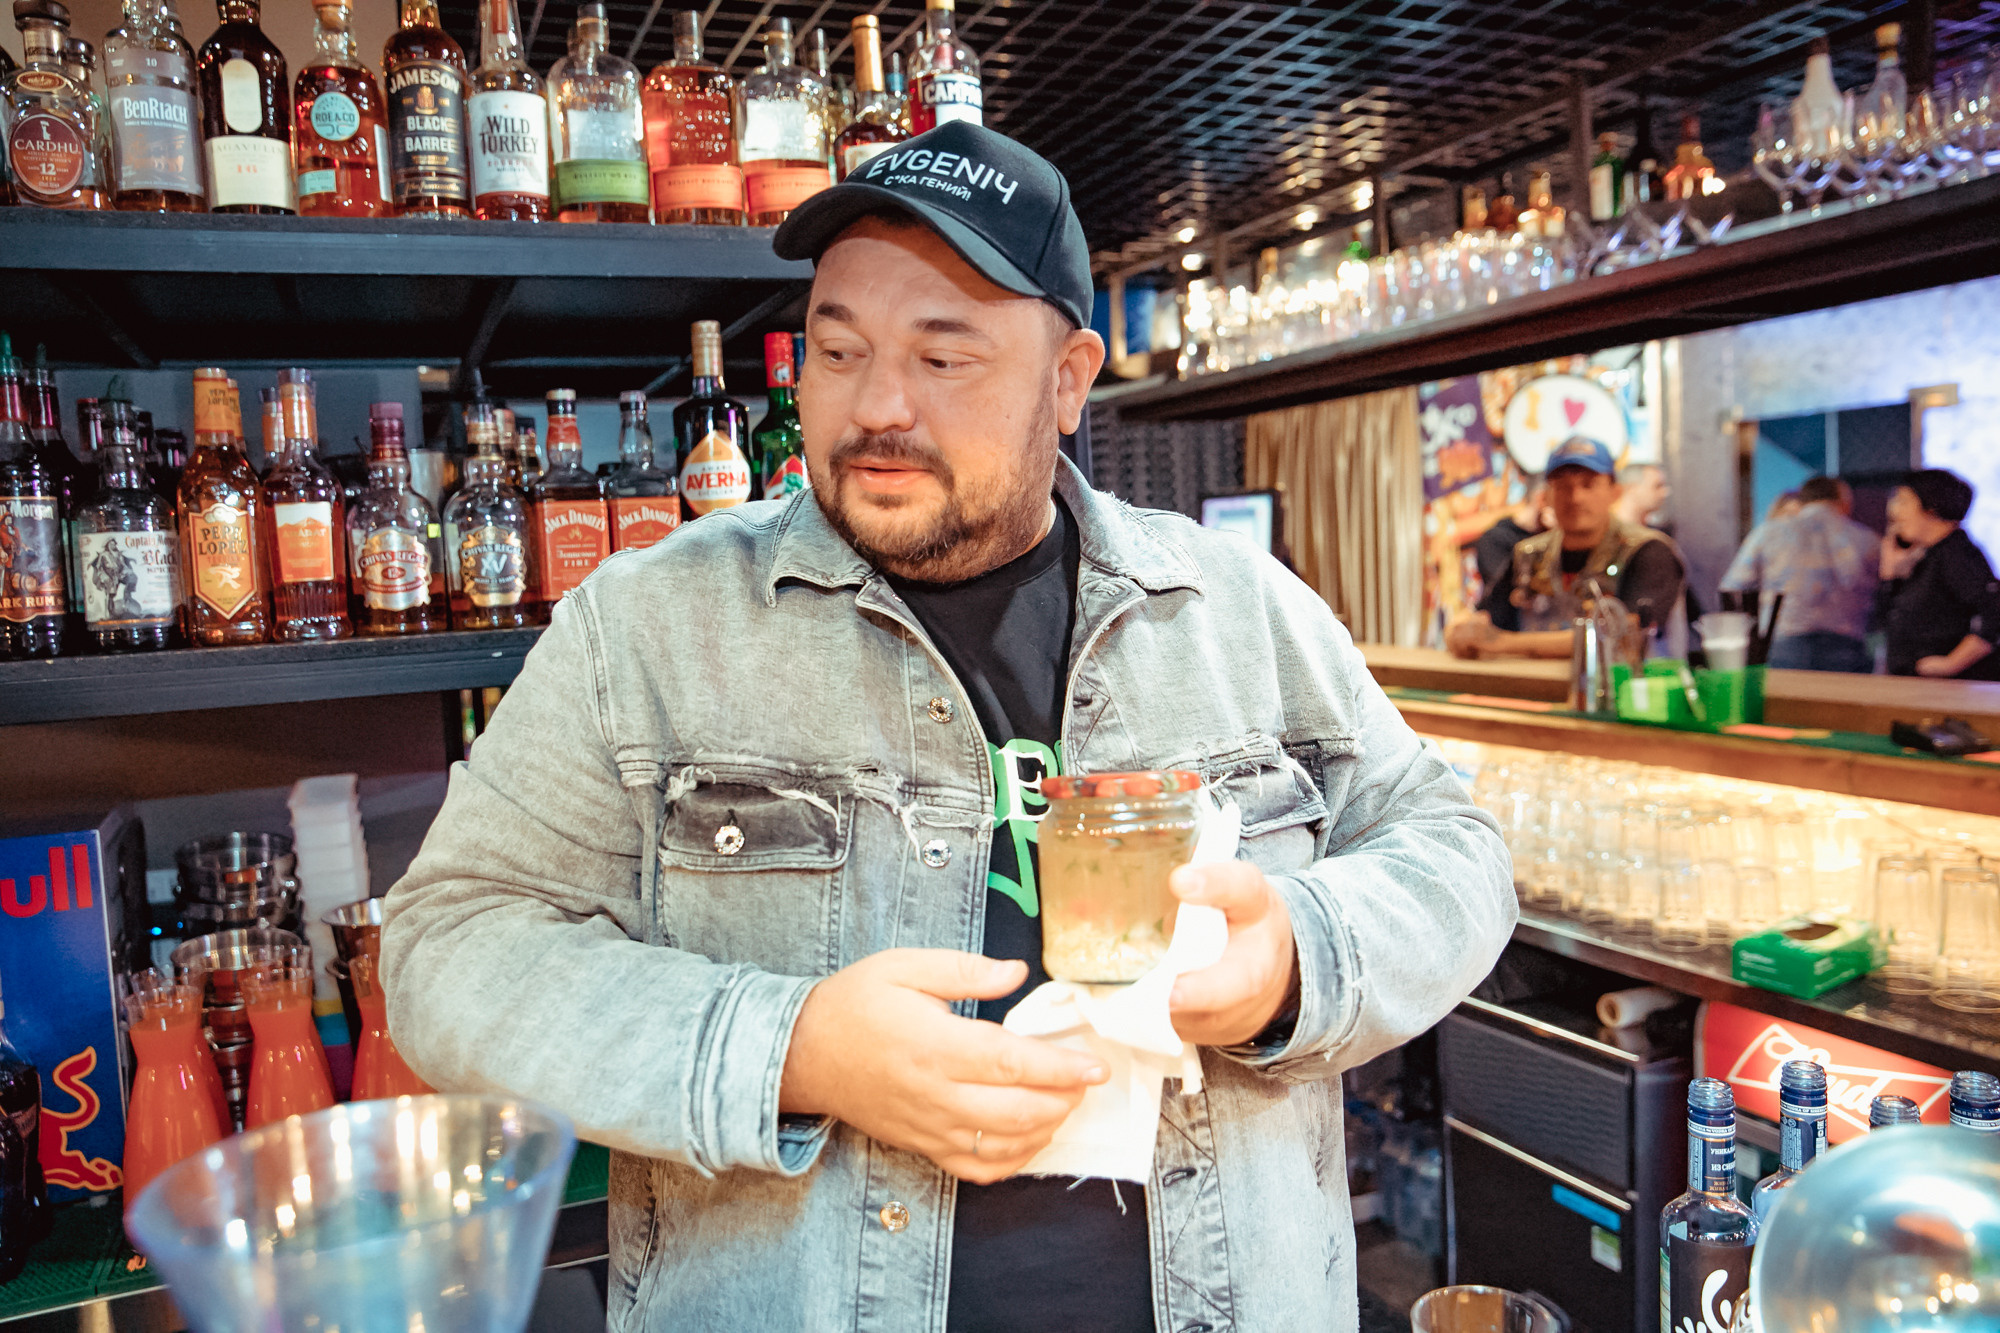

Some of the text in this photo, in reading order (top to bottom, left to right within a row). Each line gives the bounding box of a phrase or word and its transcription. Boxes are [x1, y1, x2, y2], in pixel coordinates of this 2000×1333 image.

[145, 57, 158, 67] 10
[390, 68, 460, 94] JAMESON
[342, 113, 355, 122] CO
[406, 115, 449, 132] BLACK
[486, 115, 530, 135] WILD
[14, 138, 79, 155] CARDHU
[404, 136, 455, 153] BARREL
[479, 132, 538, 155] TURKEY
[40, 162, 57, 175] 12
[918, 176, 973, 202] ГЕНИЙ!
[686, 471, 748, 491] AVERNA
[544, 513, 569, 534] JACK
[618, 509, 642, 530] JACK
[201, 526, 243, 540] PEPE
[198, 540, 249, 555] LOPEZ
[461, 543, 494, 559] CHIVAS
[360, 552, 393, 568] CHIVAS
[481, 553, 508, 577] XV
[25, 595, 56, 608] RUM
[1711, 1163, 1722, 1172] ИЗ
